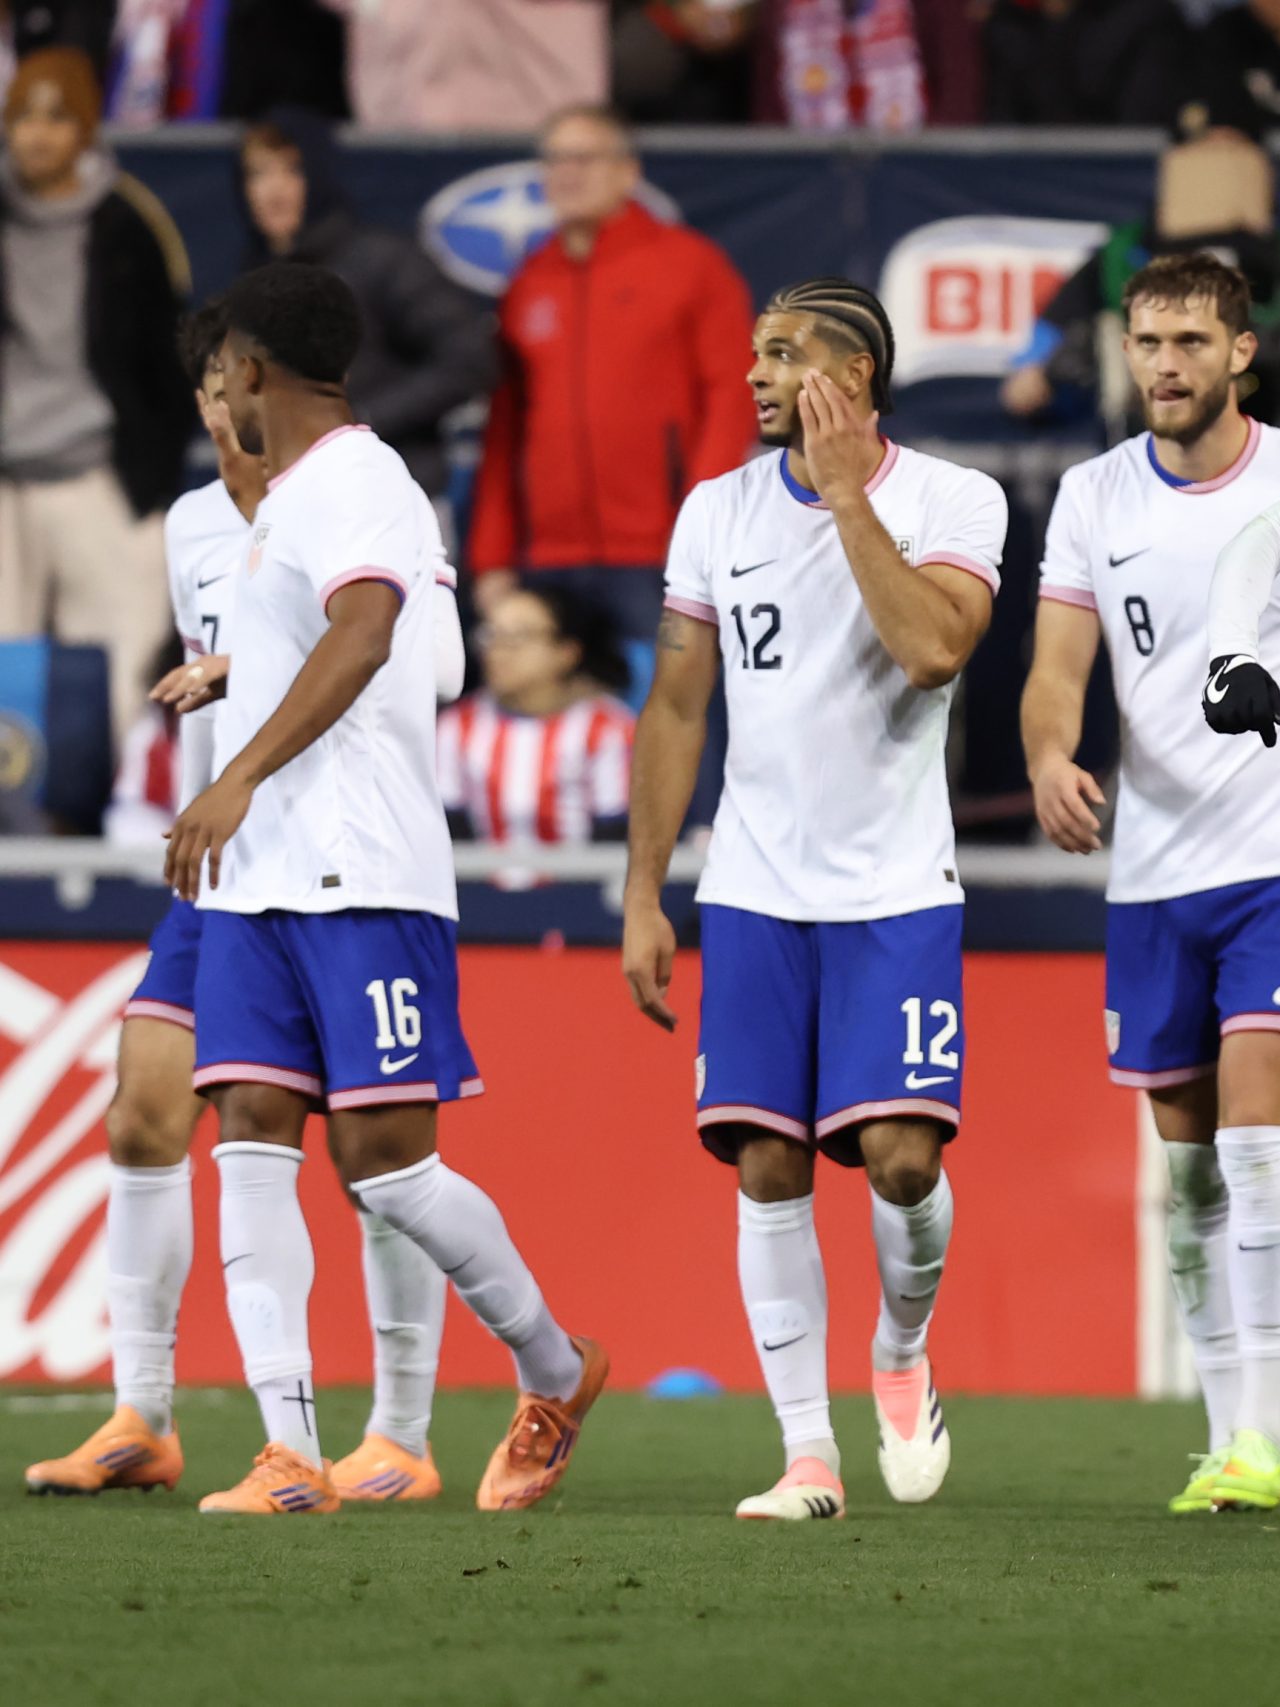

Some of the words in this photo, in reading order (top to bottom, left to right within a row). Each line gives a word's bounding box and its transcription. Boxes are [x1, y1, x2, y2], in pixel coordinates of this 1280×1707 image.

[730, 603, 782, 670] 12
[1124, 595, 1155, 656] 8
[365, 977, 422, 1049] 16
[901, 997, 959, 1070] 12
